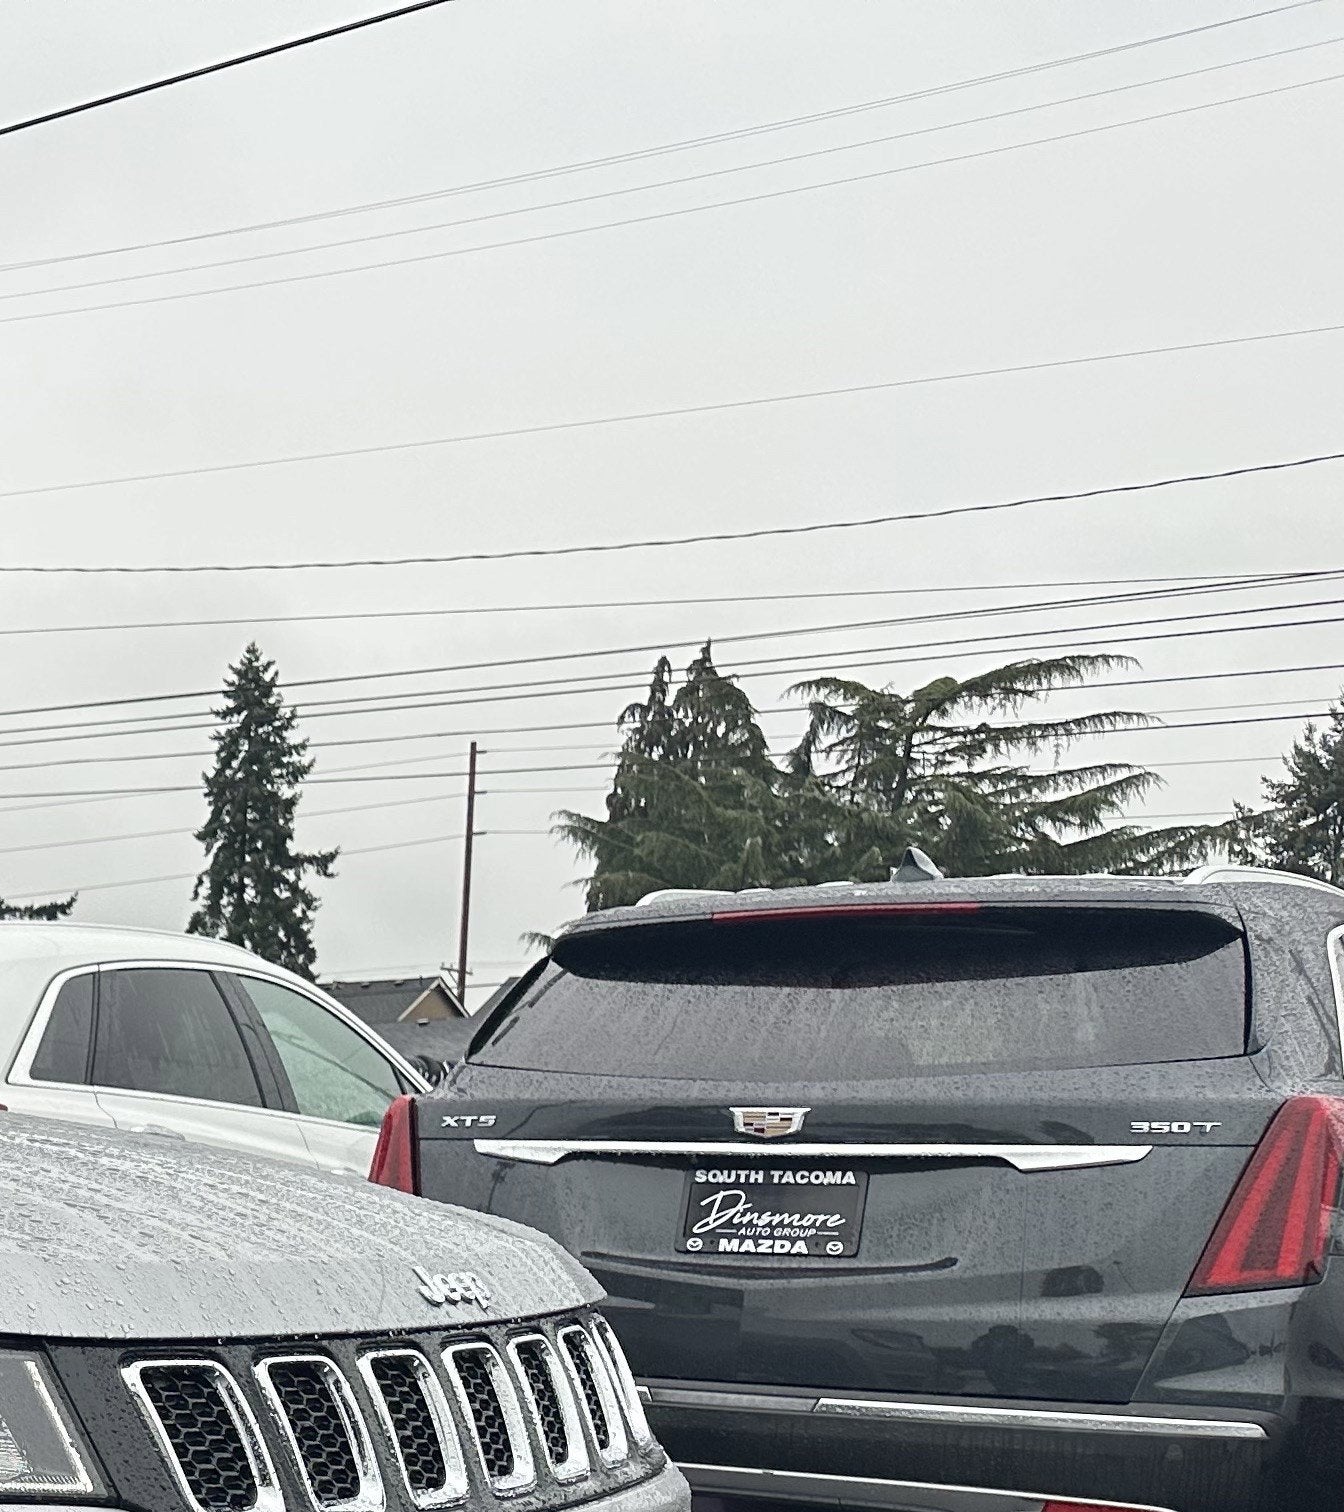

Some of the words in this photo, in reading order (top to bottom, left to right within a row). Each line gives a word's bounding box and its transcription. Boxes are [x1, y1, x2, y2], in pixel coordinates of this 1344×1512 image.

[694, 1169, 764, 1183] SOUTH
[770, 1170, 856, 1185] TACOMA
[692, 1189, 846, 1234] Dinsmore
[737, 1227, 771, 1237] AUTO
[773, 1227, 816, 1238] GROUP
[718, 1238, 809, 1255] MAZDA
[412, 1265, 492, 1310] Jeep
